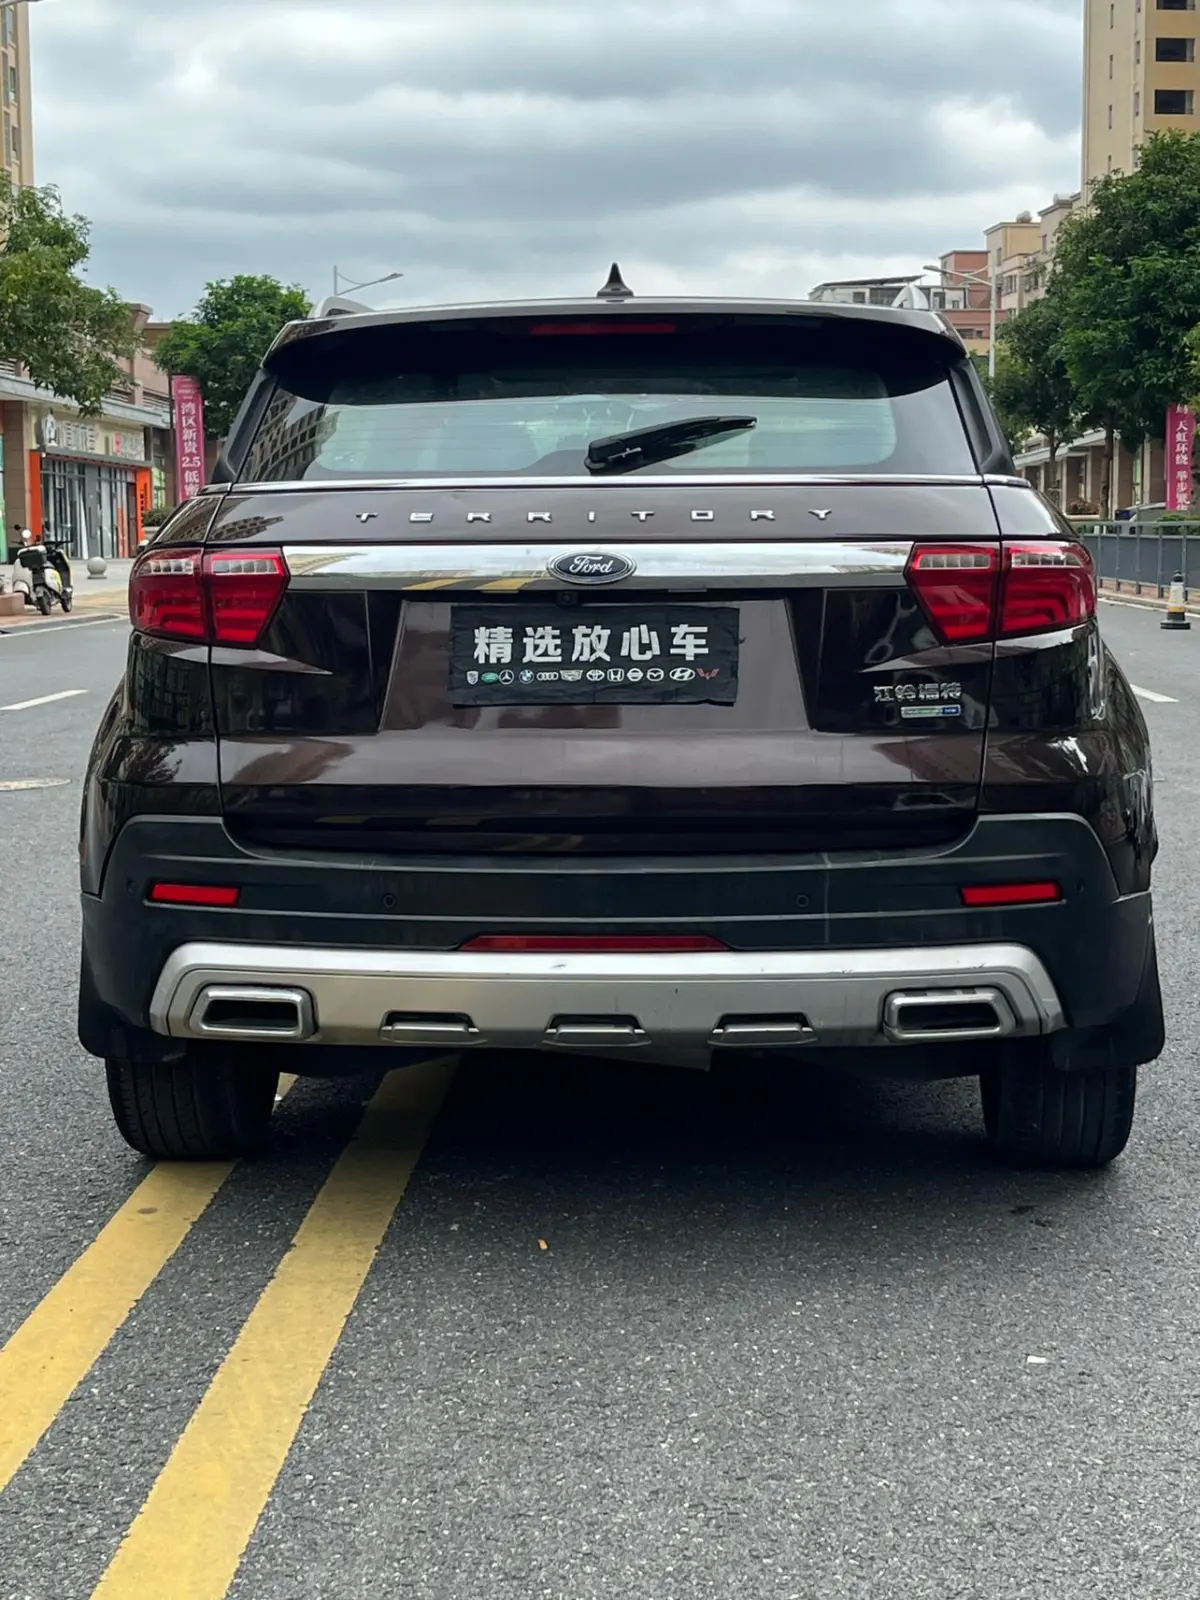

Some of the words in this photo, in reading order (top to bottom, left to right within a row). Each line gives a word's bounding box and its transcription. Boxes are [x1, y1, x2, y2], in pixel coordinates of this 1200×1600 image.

[356, 508, 834, 524] TERRITORY
[569, 555, 614, 573] Ford
[473, 624, 710, 664] 精选放心车
